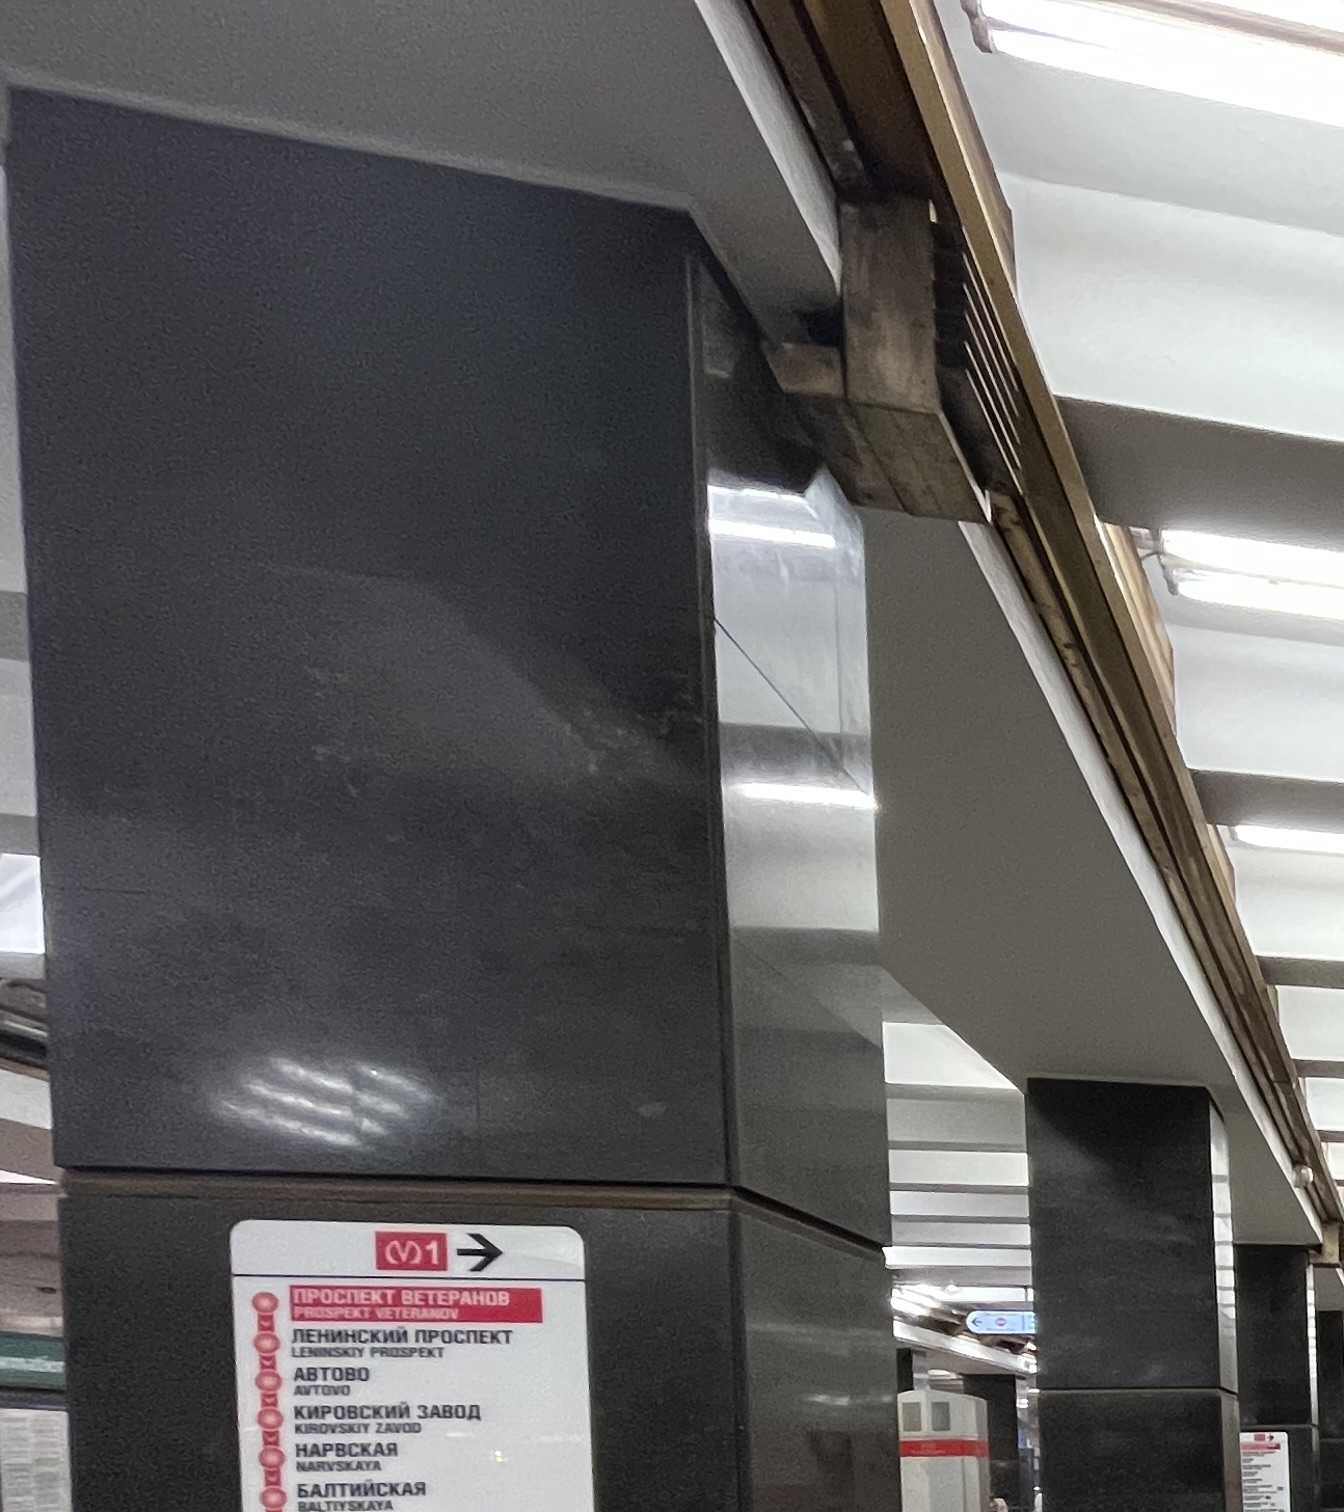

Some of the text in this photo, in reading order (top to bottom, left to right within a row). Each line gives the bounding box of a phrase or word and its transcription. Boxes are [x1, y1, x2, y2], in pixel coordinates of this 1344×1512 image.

[294, 1288, 510, 1306] ПРОСПЕКТ ВЕТЕРАНОВ
[292, 1327, 513, 1344] ЛЕНИНСКИЙ ПРОСПЕКТ
[294, 1367, 370, 1382] АВТОВО
[294, 1401, 481, 1422] КИРОВСКИЙ ЗАВОД
[296, 1443, 398, 1459] НАРВСКАЯ
[298, 1479, 426, 1497] БАЛТИЙСКАЯ
